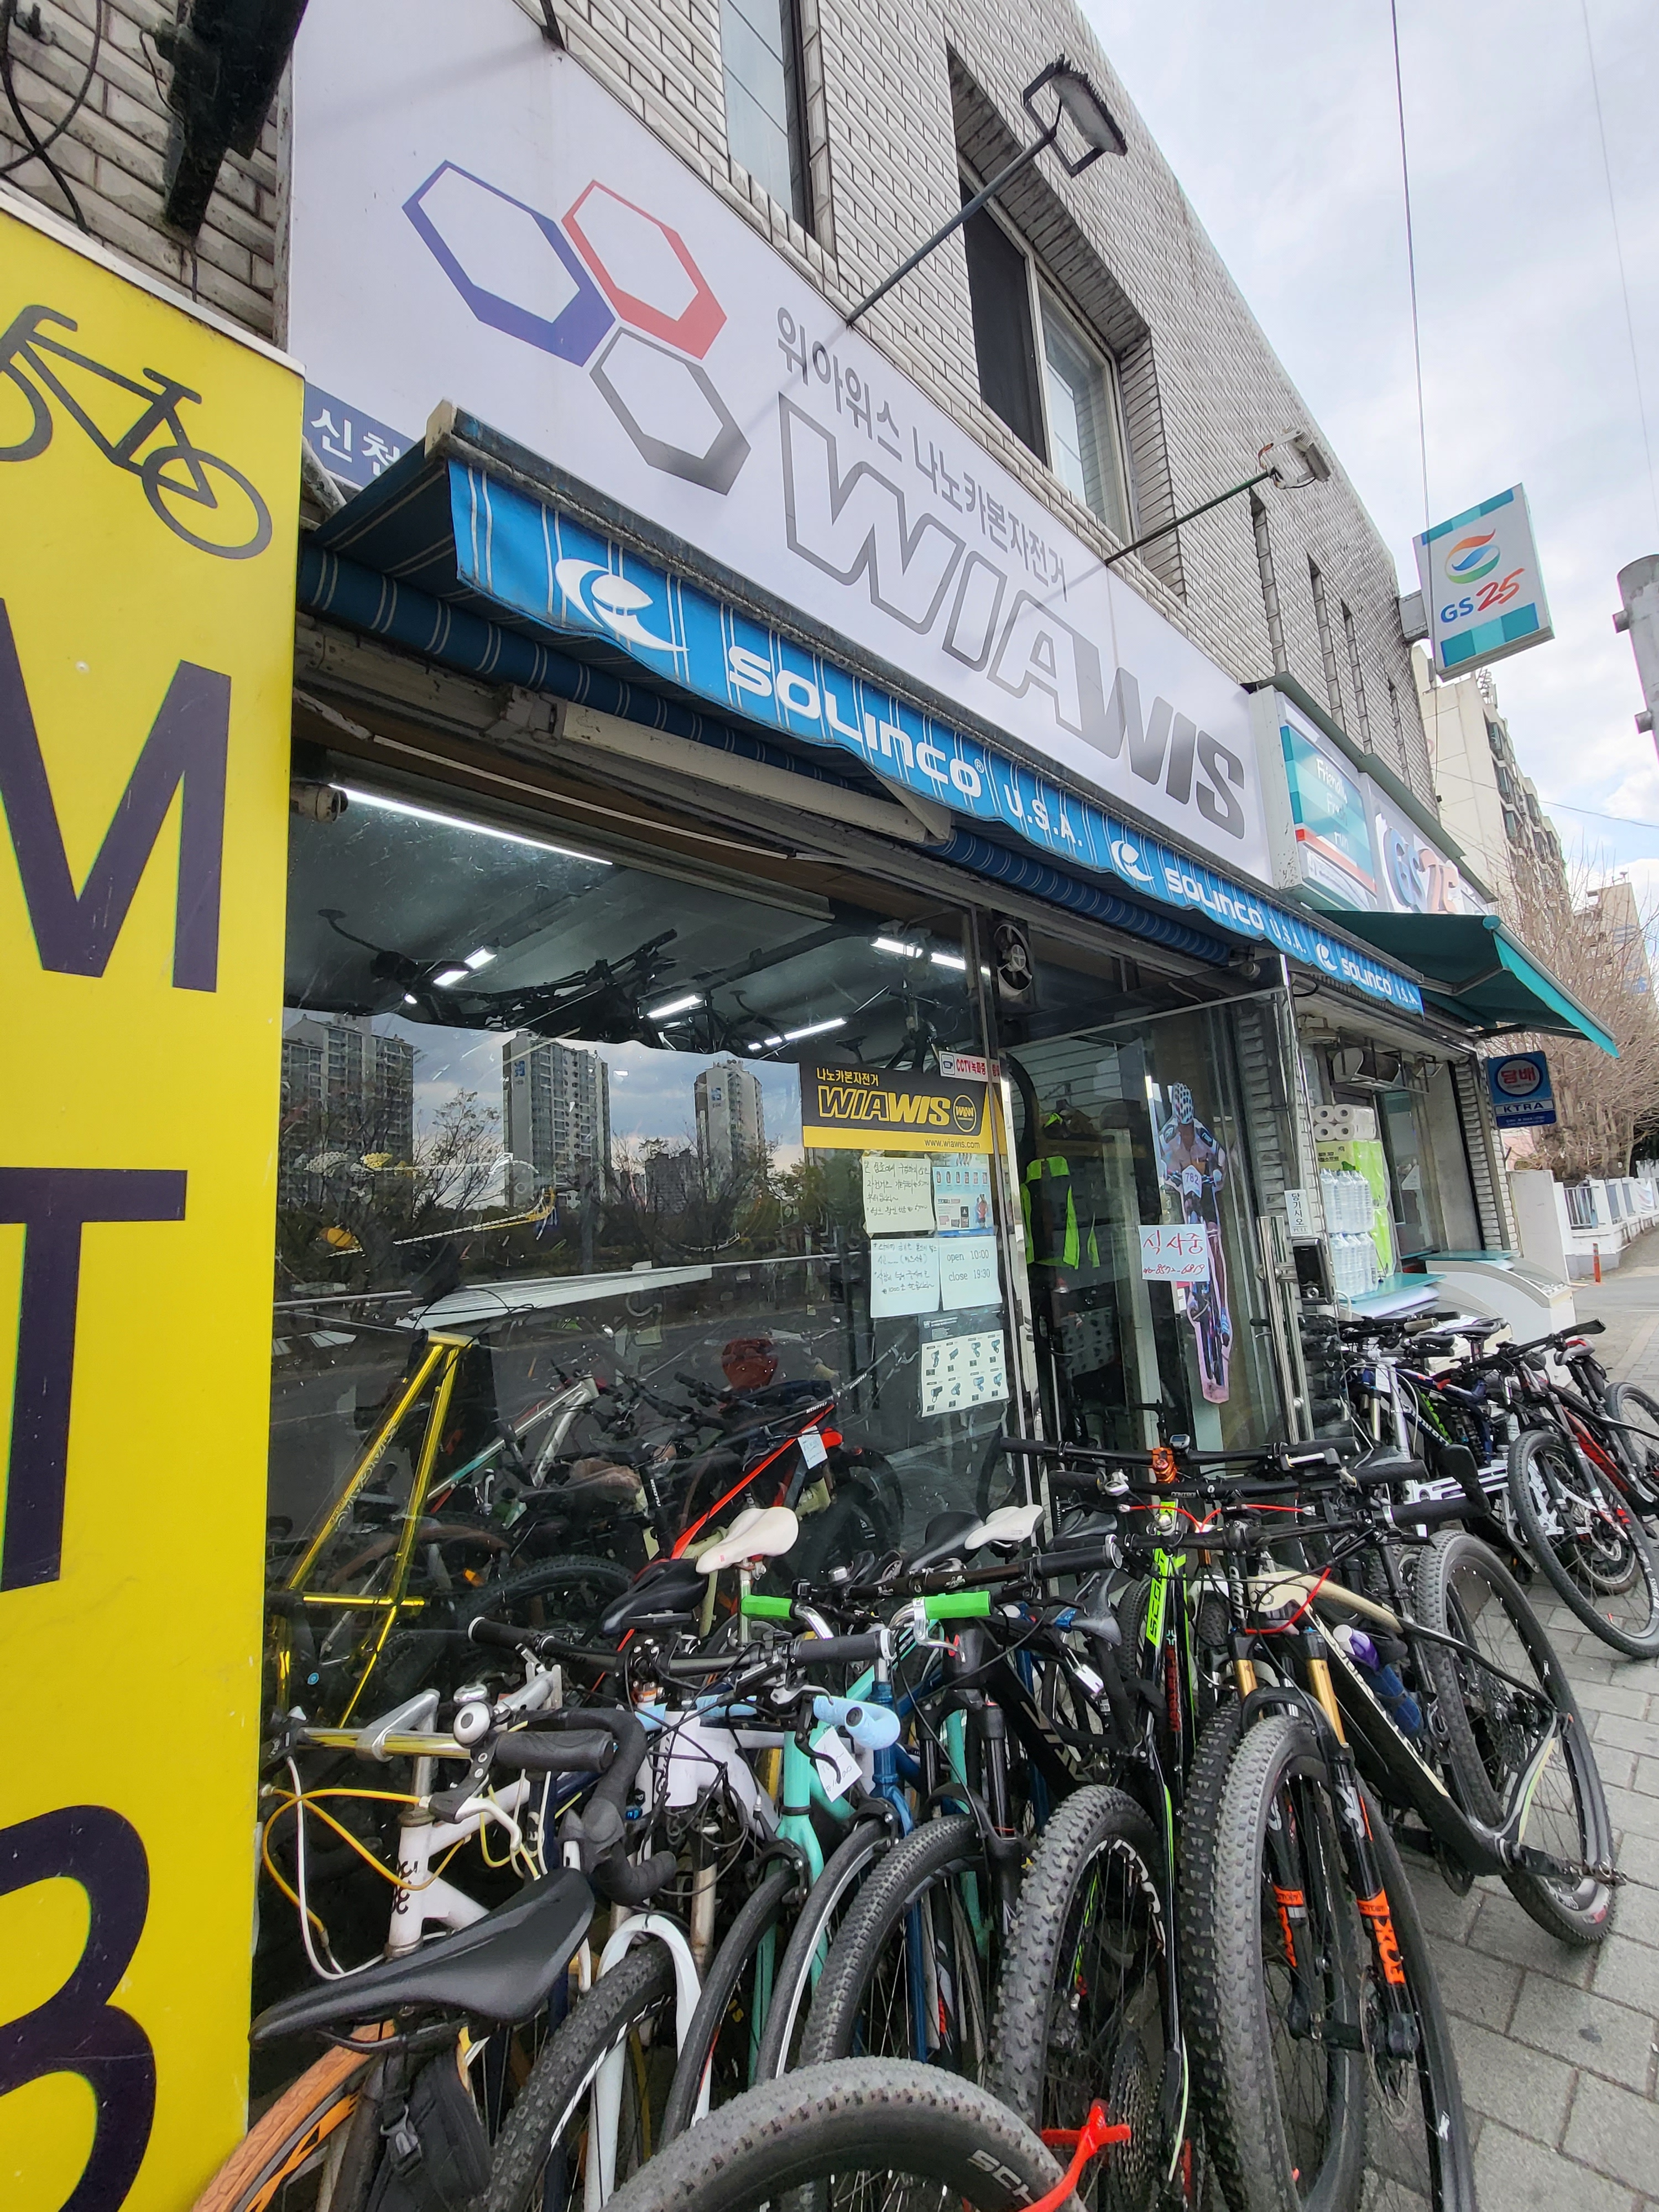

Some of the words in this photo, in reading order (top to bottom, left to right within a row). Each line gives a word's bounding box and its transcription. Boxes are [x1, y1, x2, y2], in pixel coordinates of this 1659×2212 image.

[777, 306, 902, 462] 위아위스
[912, 425, 1068, 603] 나노카본자전거
[1439, 568, 1526, 624] GS25
[778, 390, 1245, 841] WIAWIS
[1003, 783, 1084, 848] U.S.A.
[1333, 831, 1349, 852] Fun
[1269, 918, 1307, 954] U.S.A.
[816, 1067, 879, 1087] 나노카본자전거
[817, 1085, 952, 1126] WIAWIS
[924, 1138, 980, 1149] www.wiawis.com
[1185, 1172, 1200, 1186] 782
[1291, 1192, 1305, 1225] 당기시오
[946, 1252, 965, 1263] open
[970, 1249, 989, 1260] 10:00
[948, 1270, 969, 1282] close
[973, 1268, 991, 1280] 19:30
